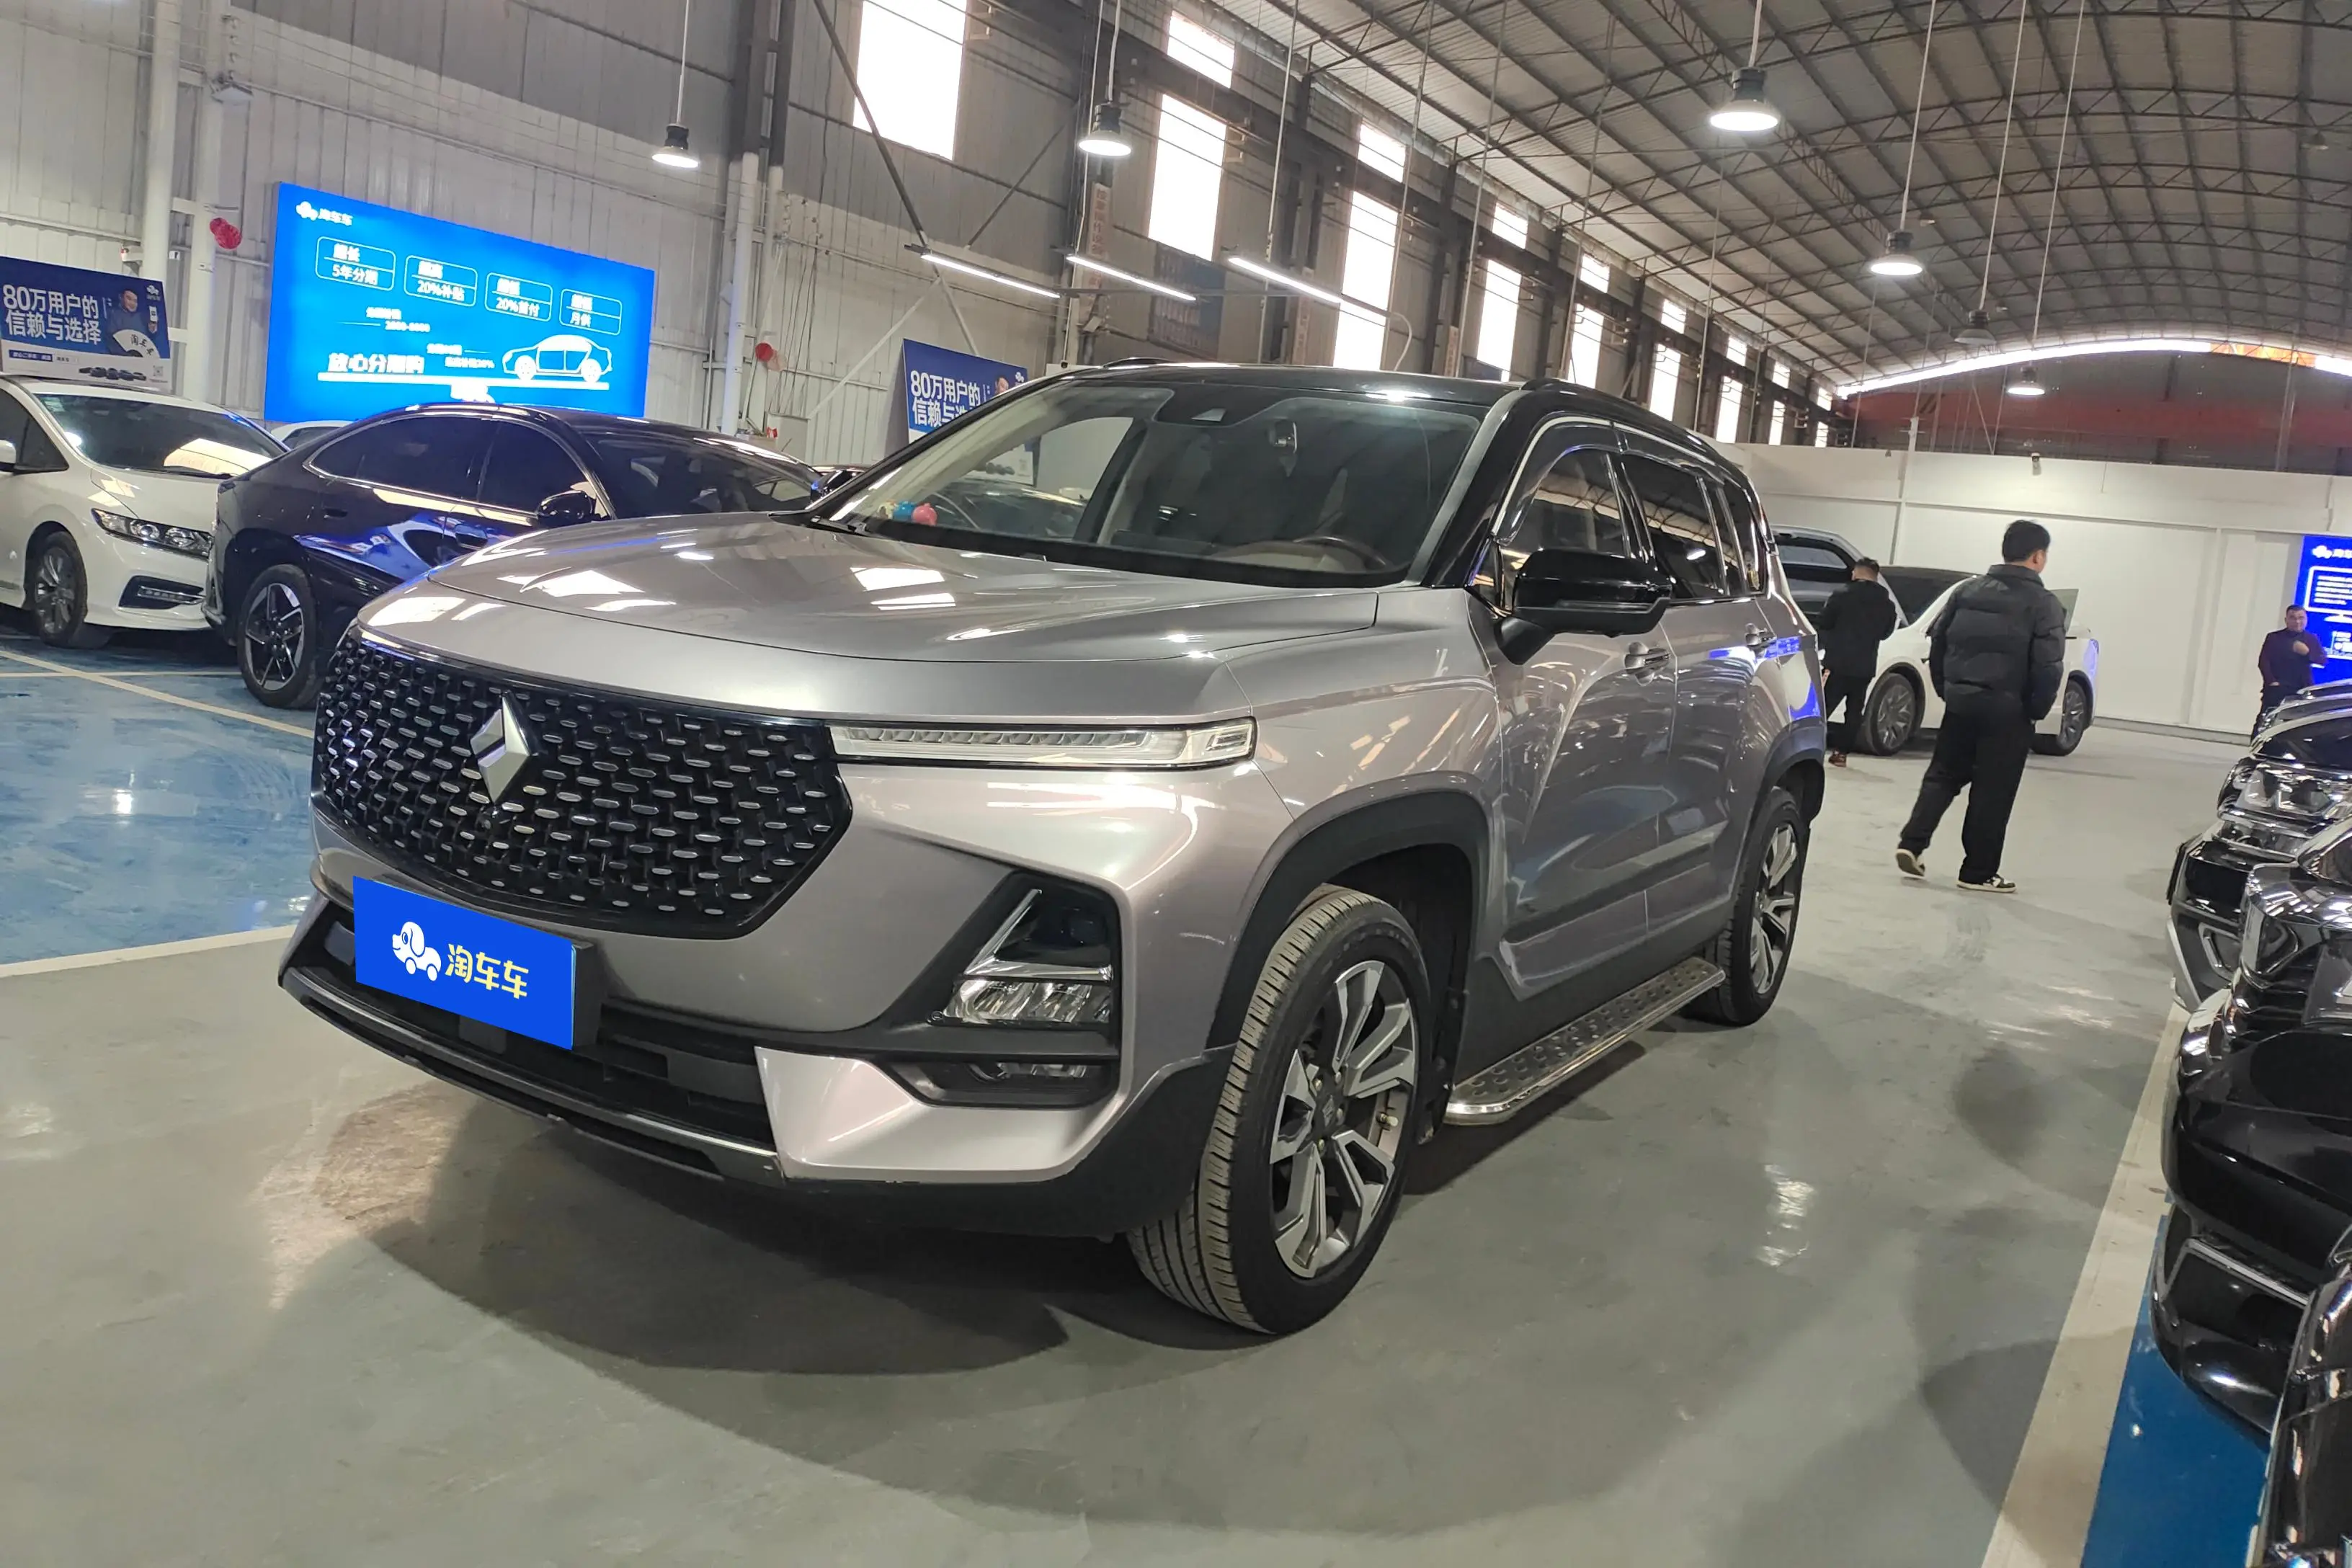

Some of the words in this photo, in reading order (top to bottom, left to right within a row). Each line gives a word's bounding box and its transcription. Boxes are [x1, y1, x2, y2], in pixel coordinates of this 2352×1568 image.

[332, 264, 378, 285] 5年分期
[3, 284, 99, 319] 80万用户的
[6, 309, 102, 345] 信赖与选择
[911, 370, 981, 406] 80万用户的
